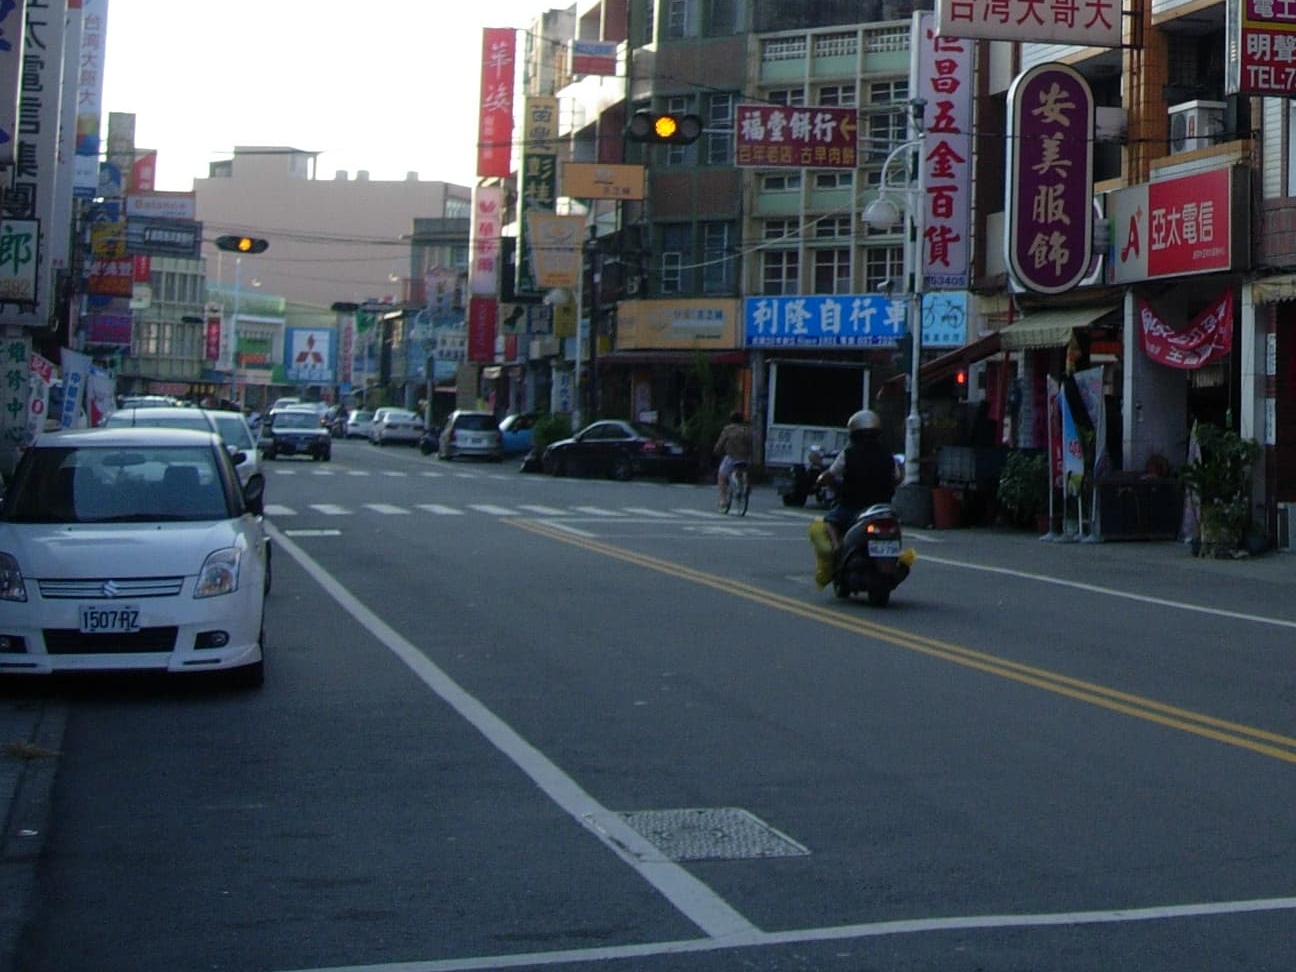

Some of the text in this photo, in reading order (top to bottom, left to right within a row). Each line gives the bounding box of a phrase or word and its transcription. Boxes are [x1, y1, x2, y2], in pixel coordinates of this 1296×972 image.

[1028, 82, 1077, 277] 安美服飾
[1151, 200, 1214, 251] 亞太電信
